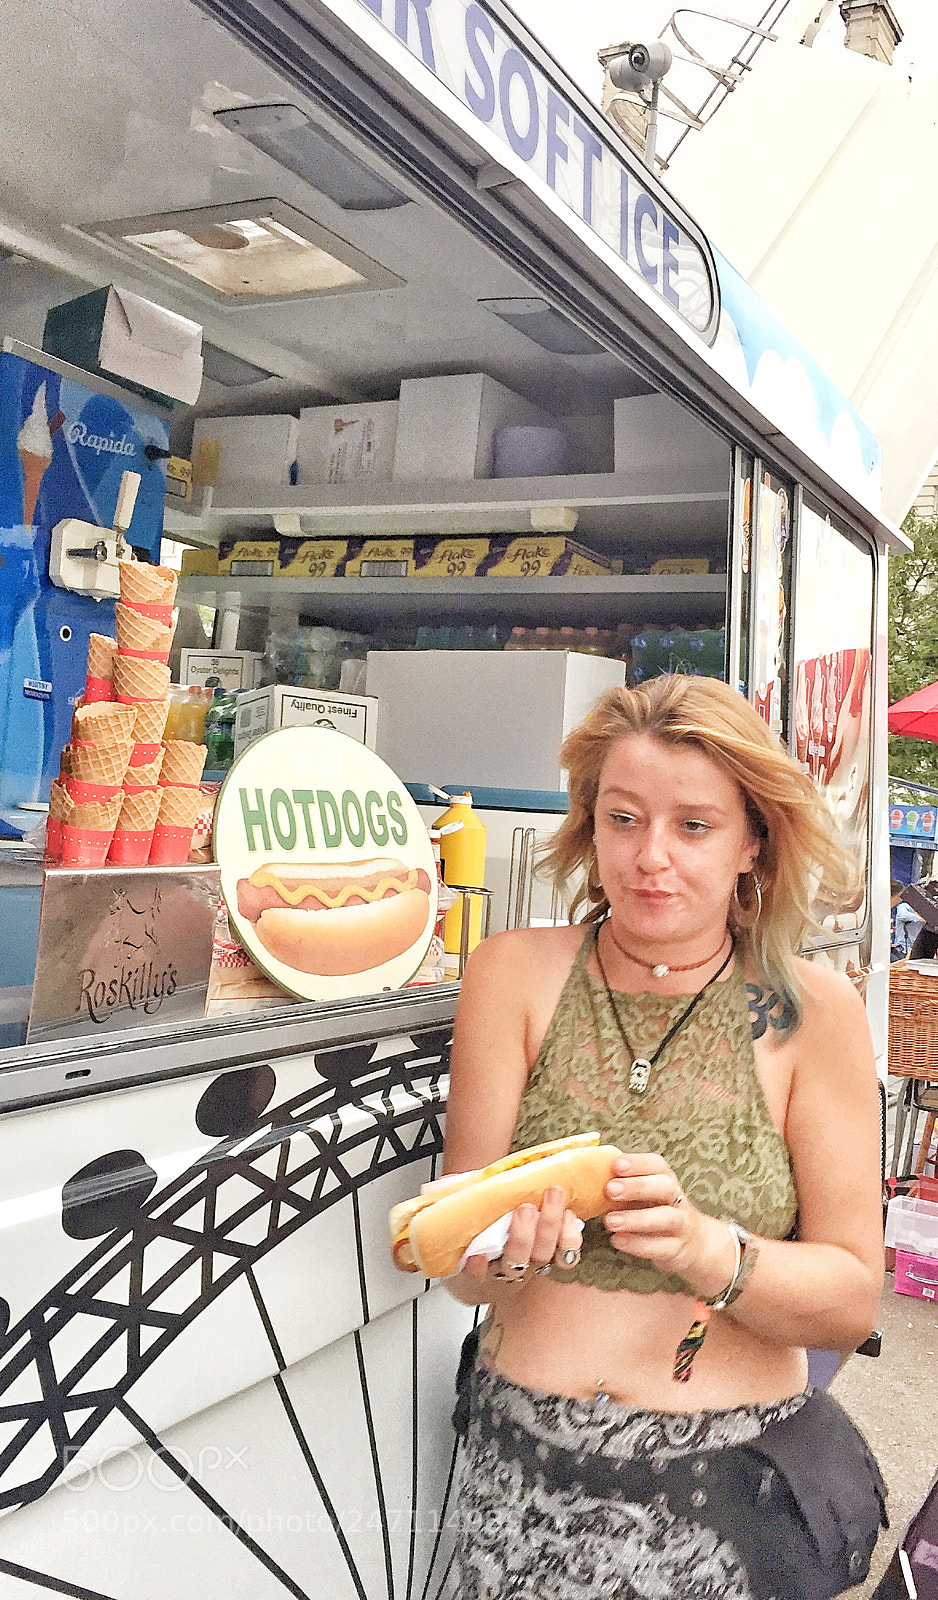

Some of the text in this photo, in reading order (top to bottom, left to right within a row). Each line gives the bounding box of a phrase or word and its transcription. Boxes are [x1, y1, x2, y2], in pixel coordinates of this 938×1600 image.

[464, 3, 603, 227] SOFT
[620, 169, 680, 310] ICE
[68, 420, 138, 457] Rapida
[447, 561, 466, 577] 99
[520, 560, 542, 577] 99
[290, 698, 358, 718] Finest Quality
[239, 787, 408, 851] HOTDOGS
[75, 962, 178, 1024] Roskilly's
